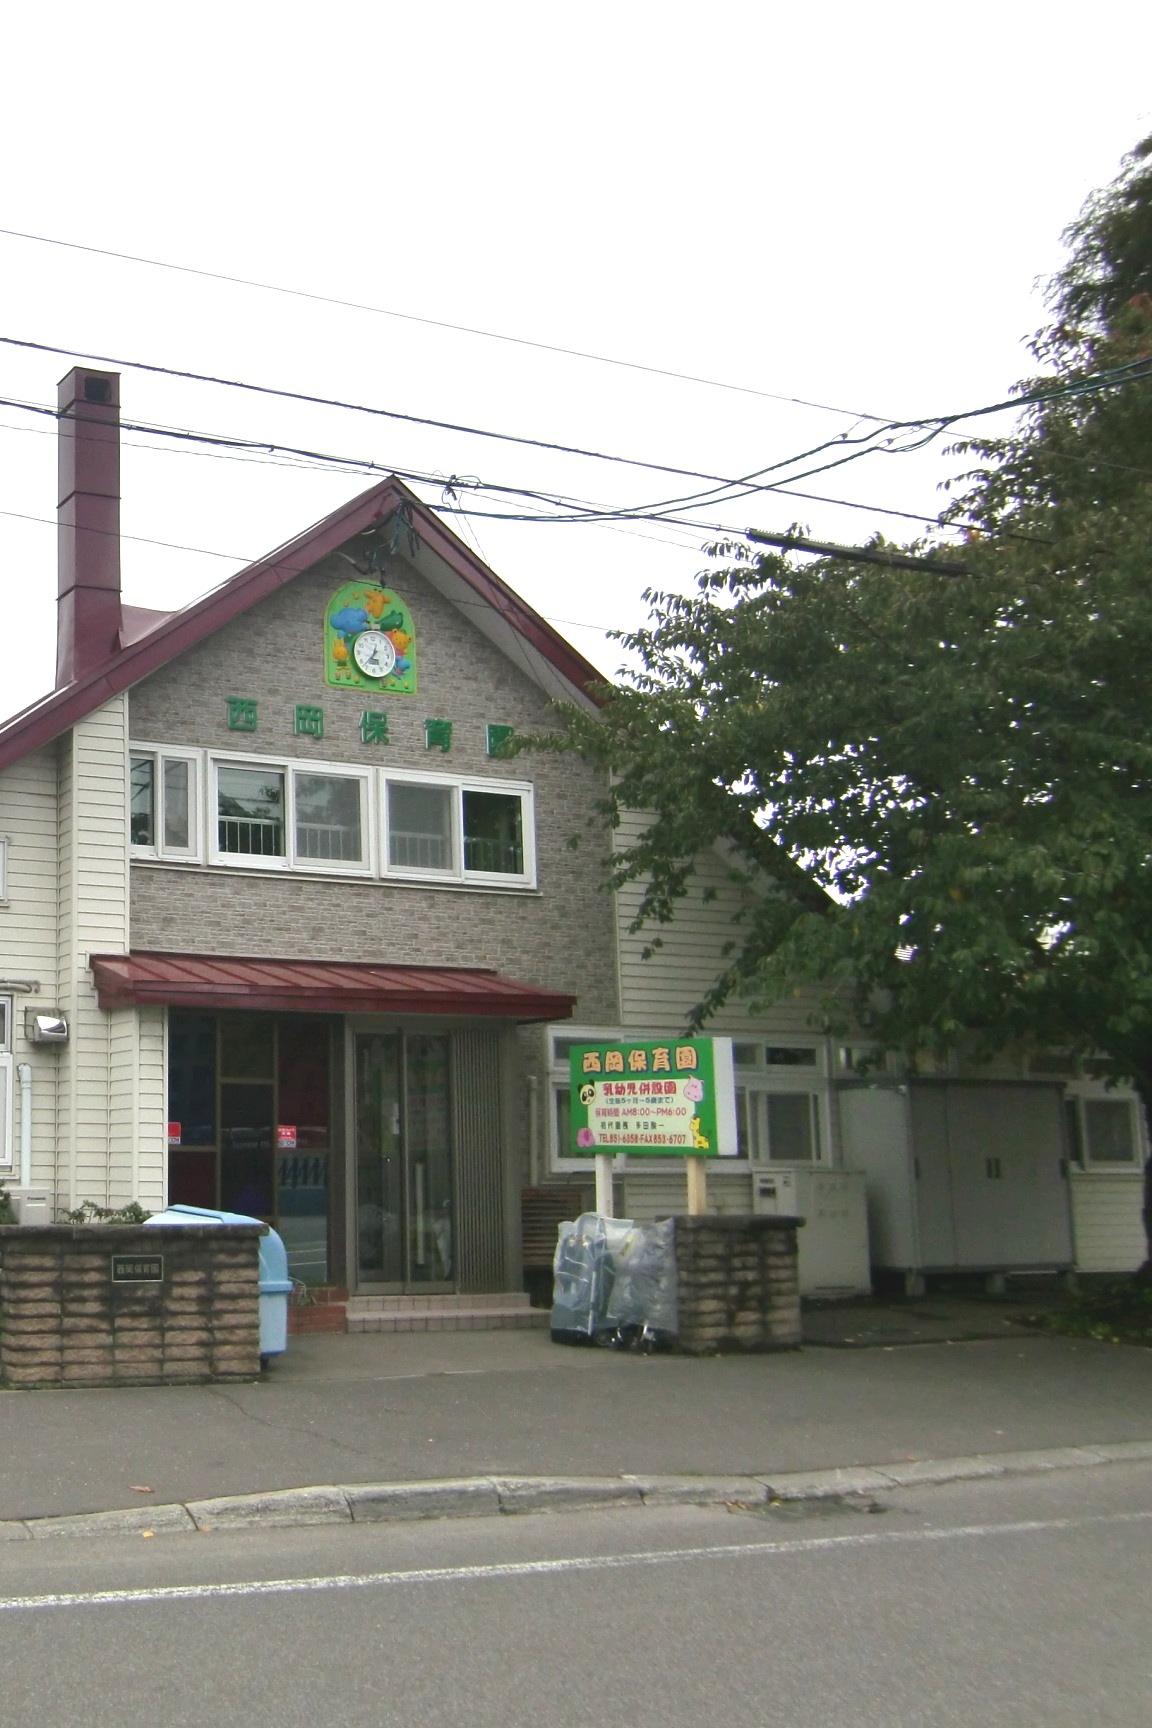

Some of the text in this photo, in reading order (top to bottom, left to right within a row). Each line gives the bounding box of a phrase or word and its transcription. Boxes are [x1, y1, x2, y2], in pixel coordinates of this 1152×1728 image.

[583, 1046, 697, 1073] 西岡保育園
